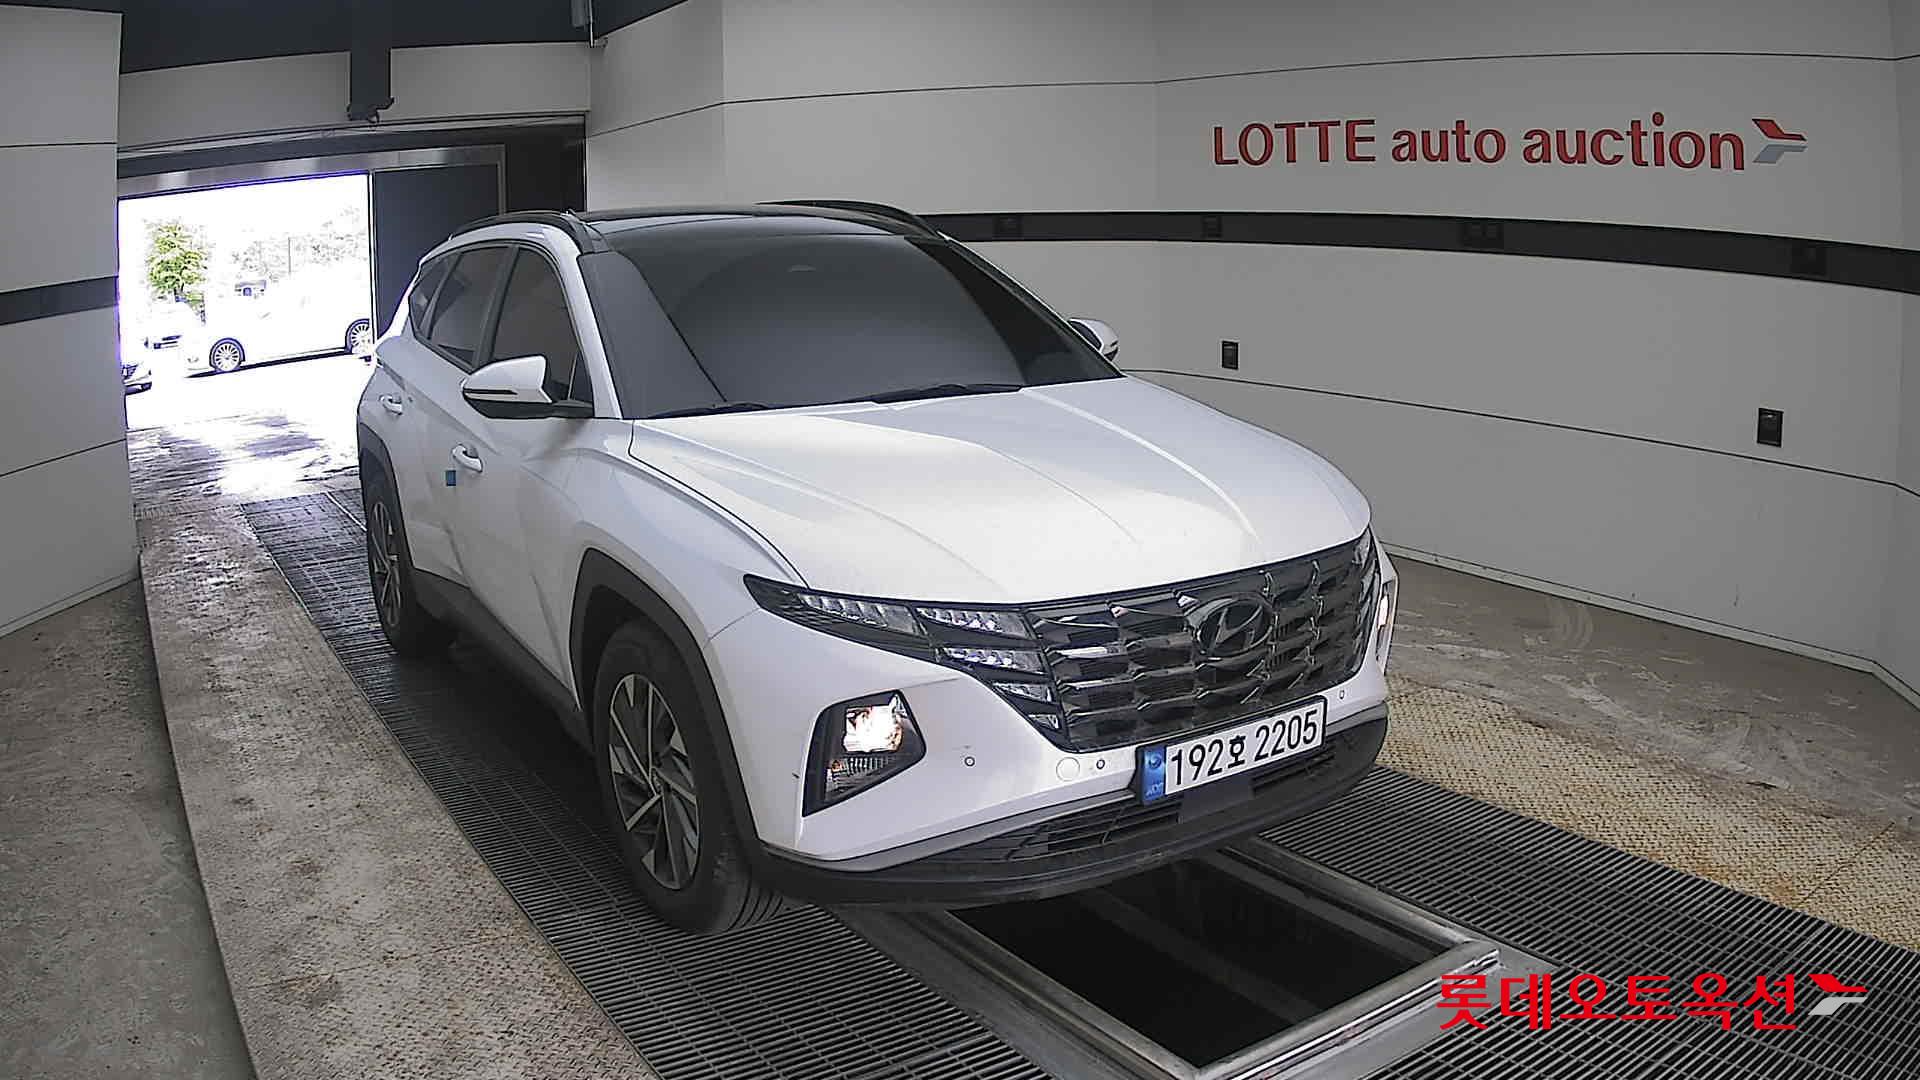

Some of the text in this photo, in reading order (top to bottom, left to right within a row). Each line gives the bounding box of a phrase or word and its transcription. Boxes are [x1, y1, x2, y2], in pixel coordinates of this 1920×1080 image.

[1213, 111, 1745, 171] LOTTE auto auction
[1171, 708, 1319, 786] 192호 2205
